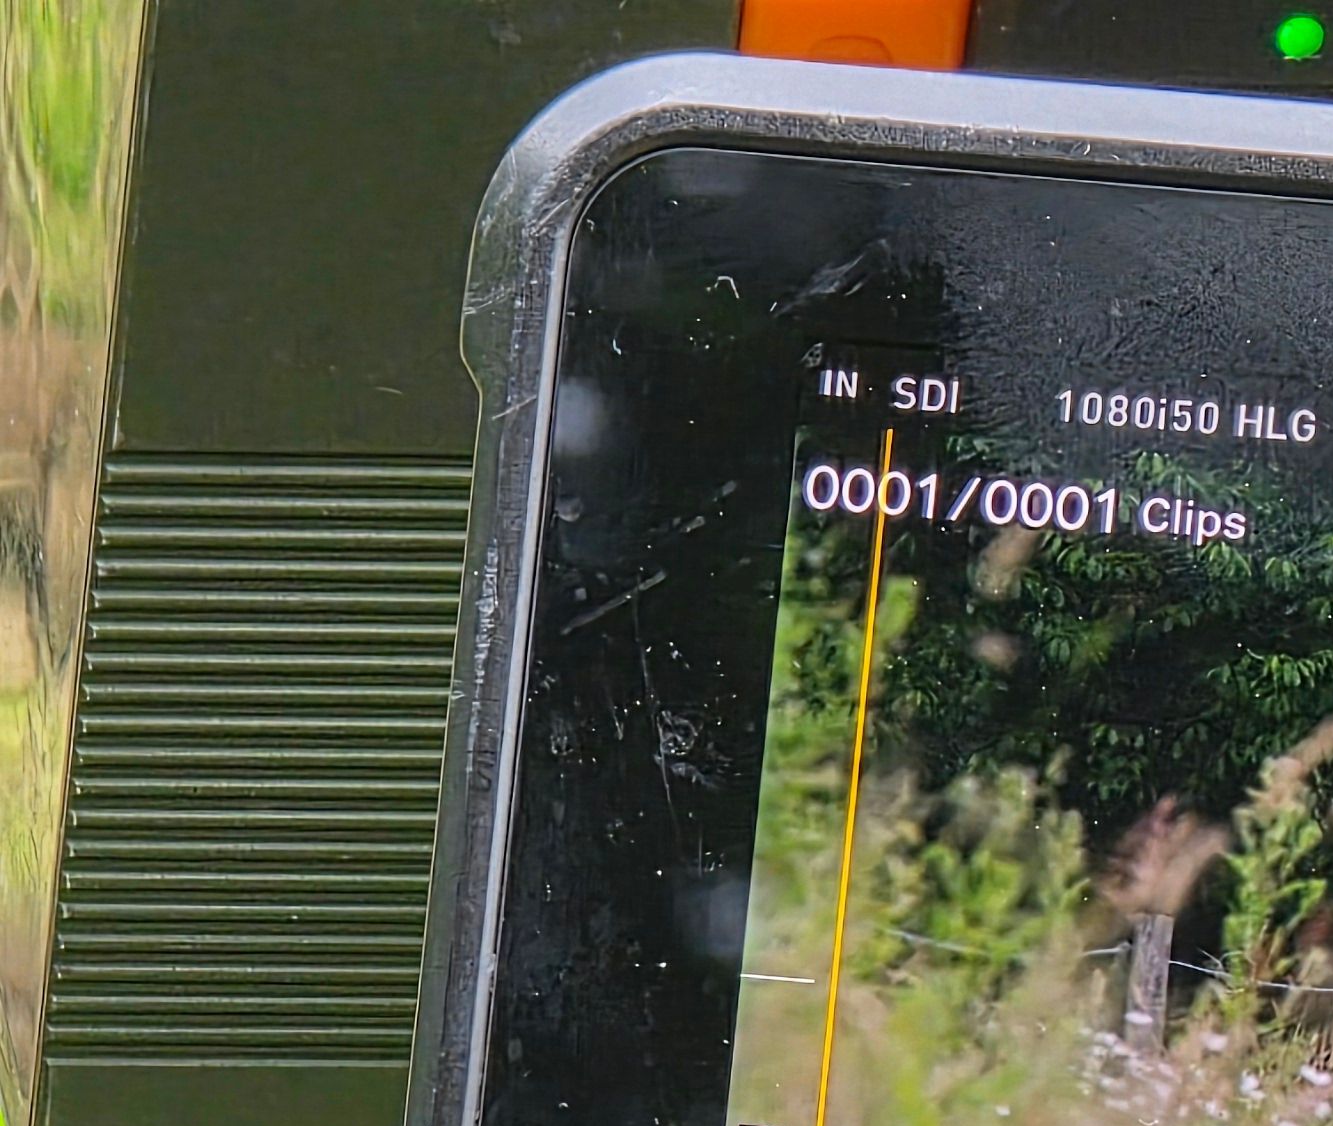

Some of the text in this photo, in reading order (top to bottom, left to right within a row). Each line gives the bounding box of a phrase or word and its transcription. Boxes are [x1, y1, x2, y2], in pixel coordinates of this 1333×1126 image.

[821, 369, 960, 415] IN SDI
[1057, 389, 1319, 444] 1080i50 HLG
[804, 464, 1248, 546] 0001/0001 Clips
